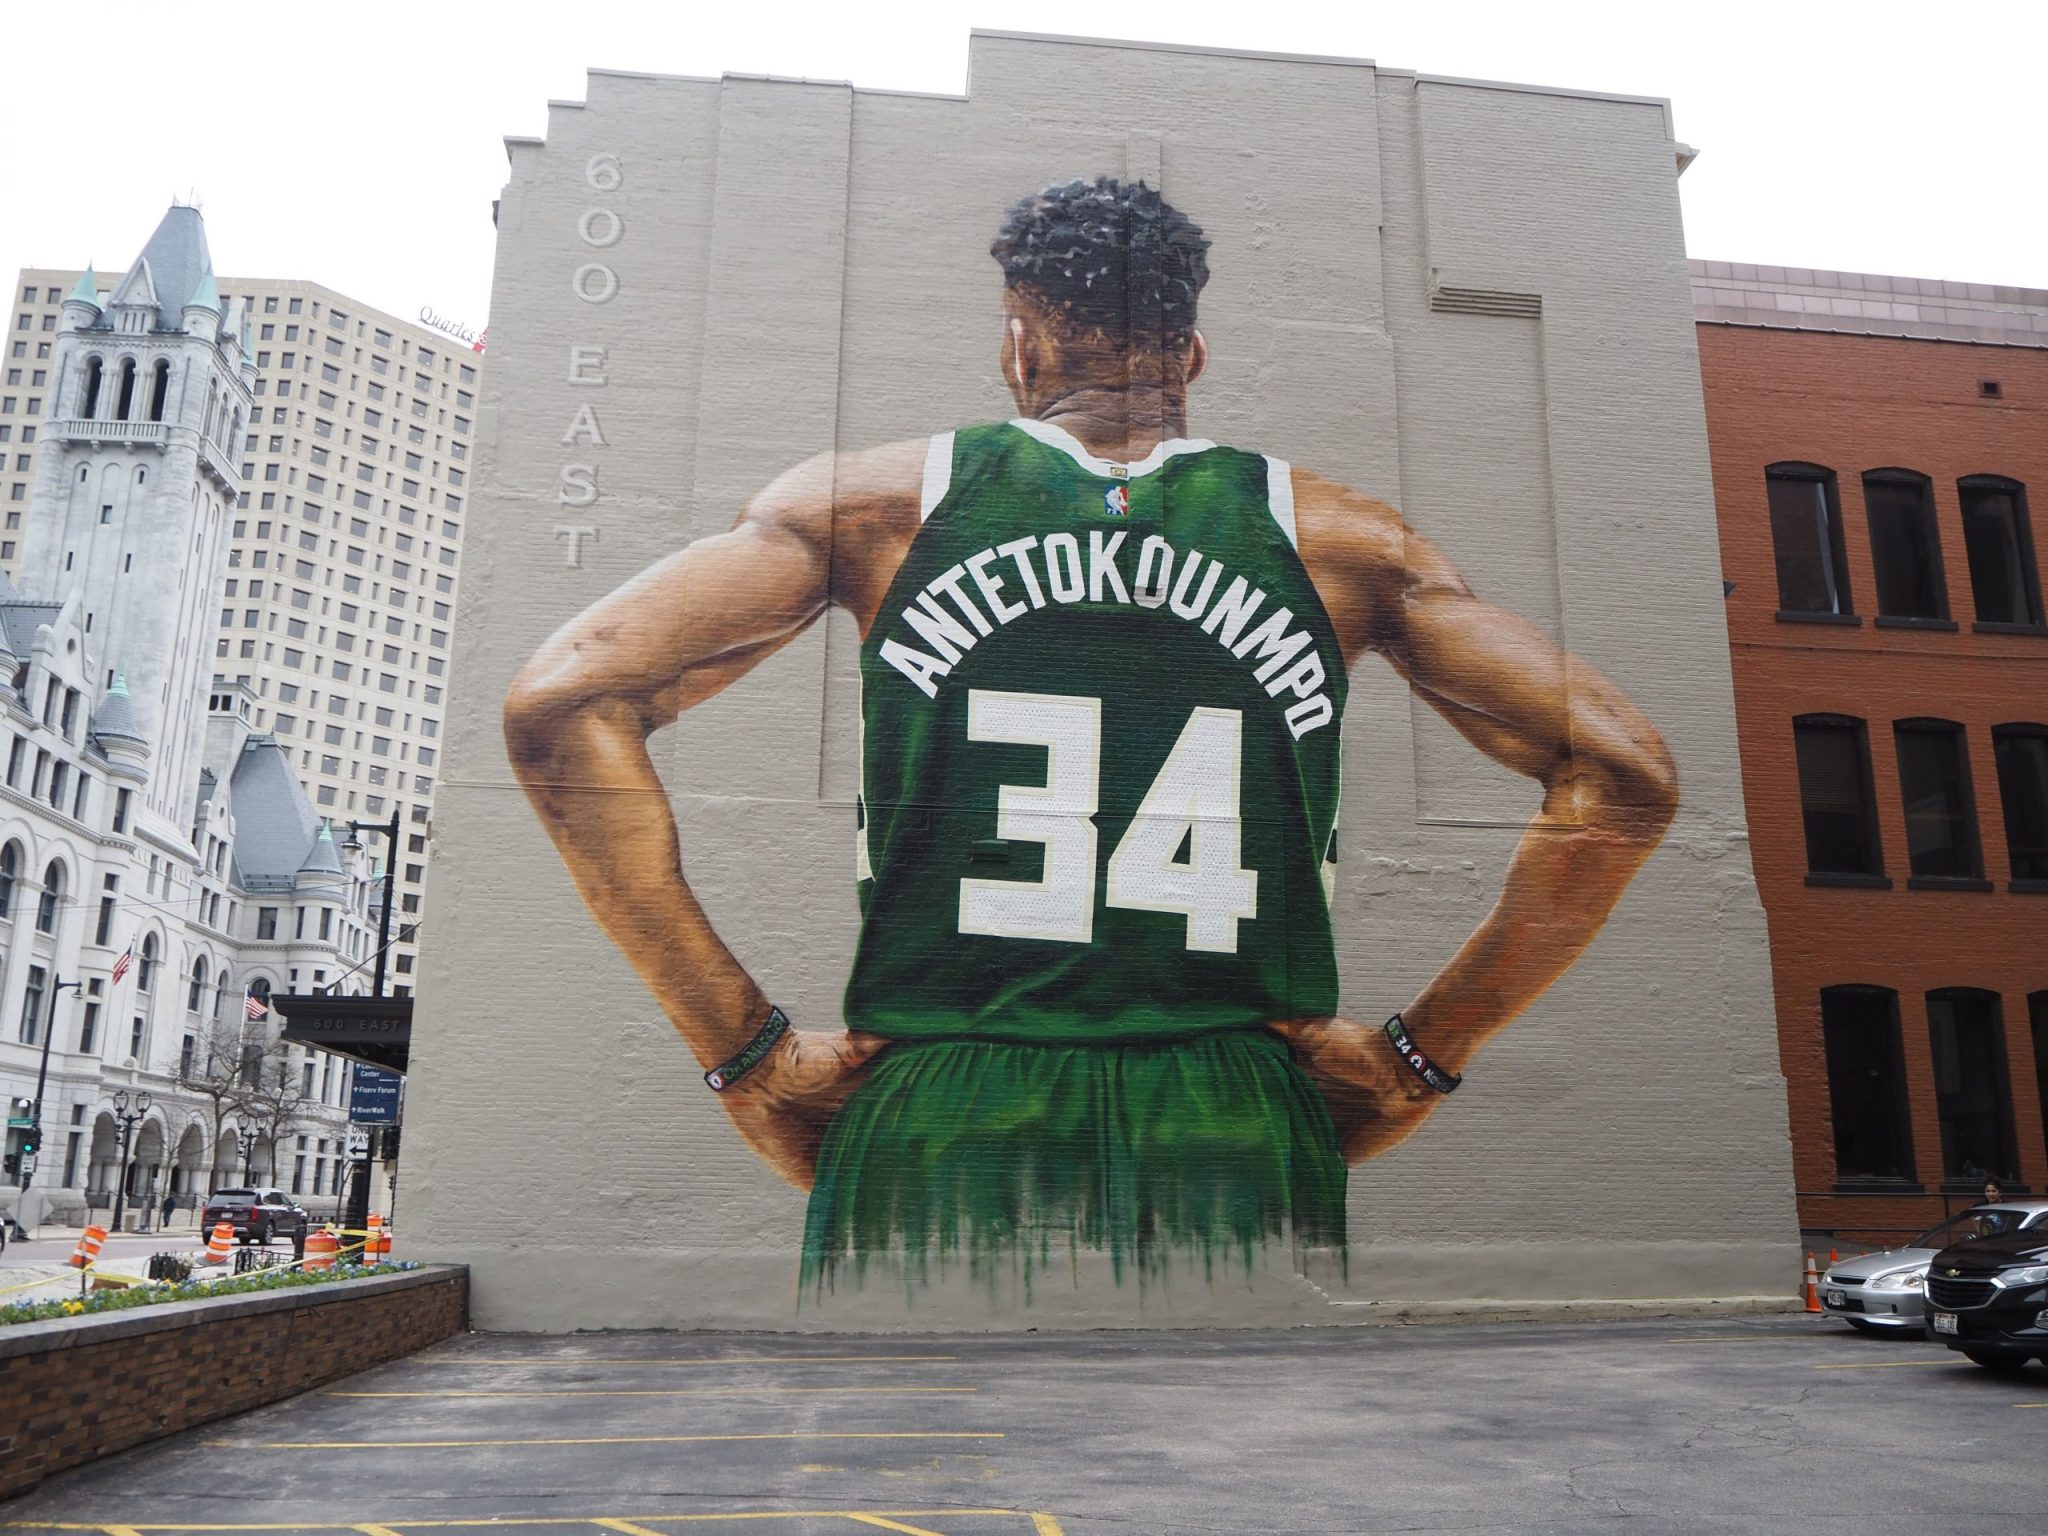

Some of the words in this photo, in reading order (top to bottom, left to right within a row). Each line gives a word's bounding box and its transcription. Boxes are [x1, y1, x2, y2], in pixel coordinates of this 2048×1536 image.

[572, 152, 624, 303] 600
[418, 305, 475, 344] Quarles
[554, 345, 609, 569] EAST
[879, 530, 1333, 741] ANTETOKOUNMPO
[958, 689, 1258, 954] 34
[314, 1018, 344, 1030] 600
[360, 1019, 400, 1031] EAST
[1395, 1035, 1412, 1054] 34
[378, 1086, 396, 1094] Forum
[357, 1106, 385, 1114] RiverWalk
[350, 1135, 369, 1143] WAY
